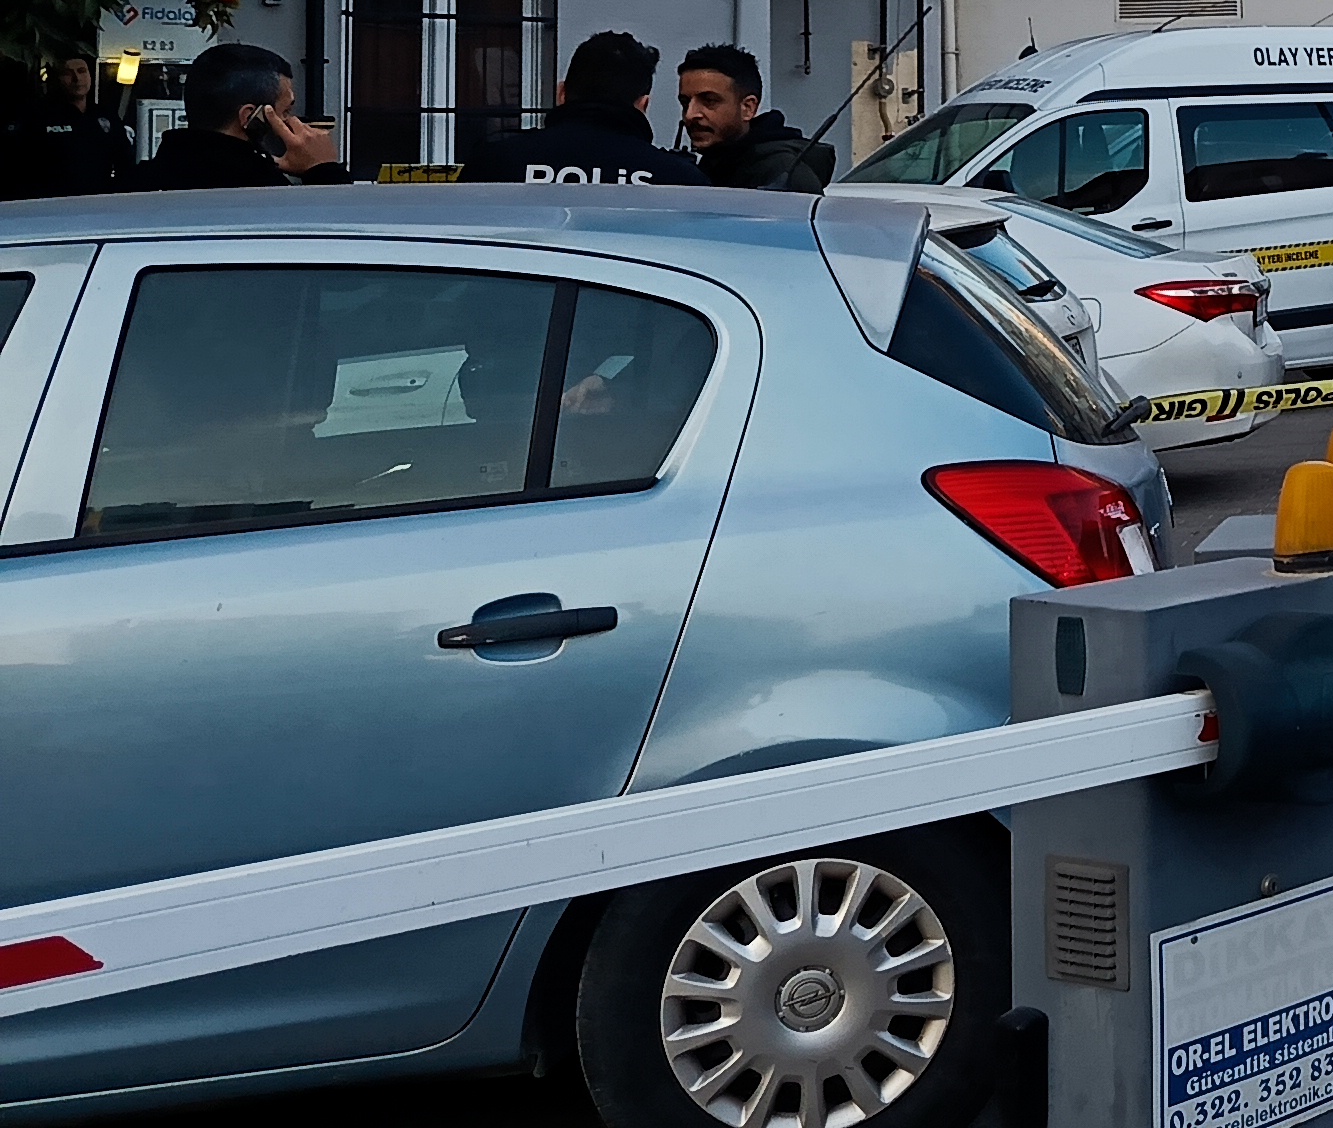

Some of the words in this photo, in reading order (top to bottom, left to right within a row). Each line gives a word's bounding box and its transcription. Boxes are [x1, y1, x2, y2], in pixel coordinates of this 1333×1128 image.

[1253, 47, 1299, 66] OLAY
[1171, 1032, 1237, 1076] OR-EL
[1186, 1052, 1270, 1095] Güvenlik
[1259, 1066, 1302, 1102] 352
